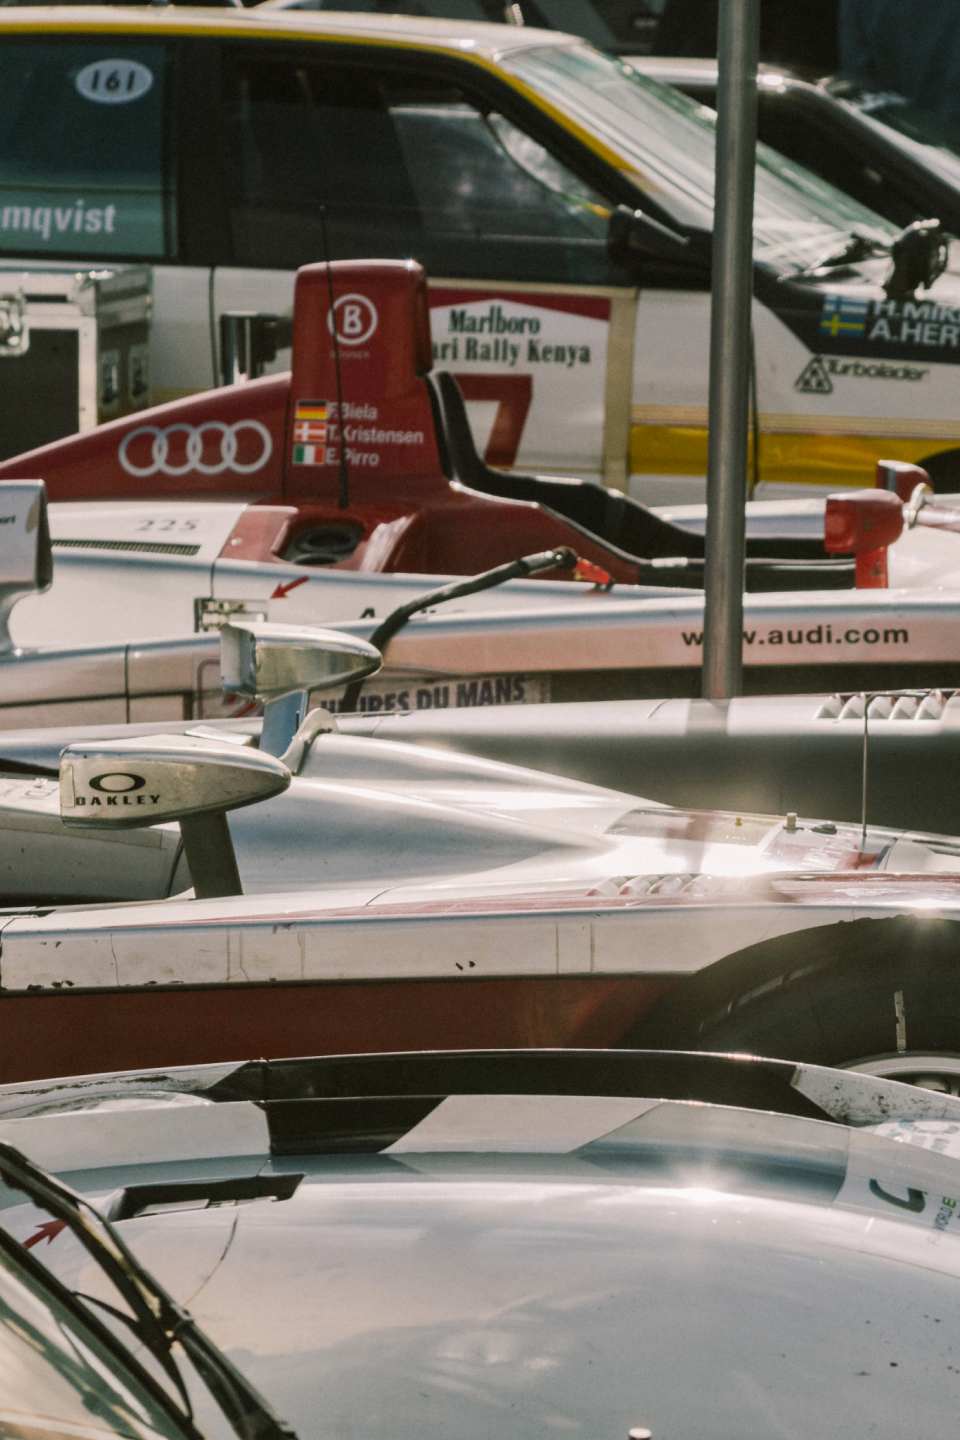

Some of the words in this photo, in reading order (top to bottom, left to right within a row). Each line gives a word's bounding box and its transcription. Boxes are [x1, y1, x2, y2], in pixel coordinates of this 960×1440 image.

[91, 70, 136, 94] 161
[449, 306, 541, 335] Marlboro
[465, 337, 520, 367] Rally
[527, 339, 591, 367] Kenya
[416, 686, 449, 710] DU
[456, 675, 527, 707] MANS
[75, 795, 161, 807] OAKLEY
